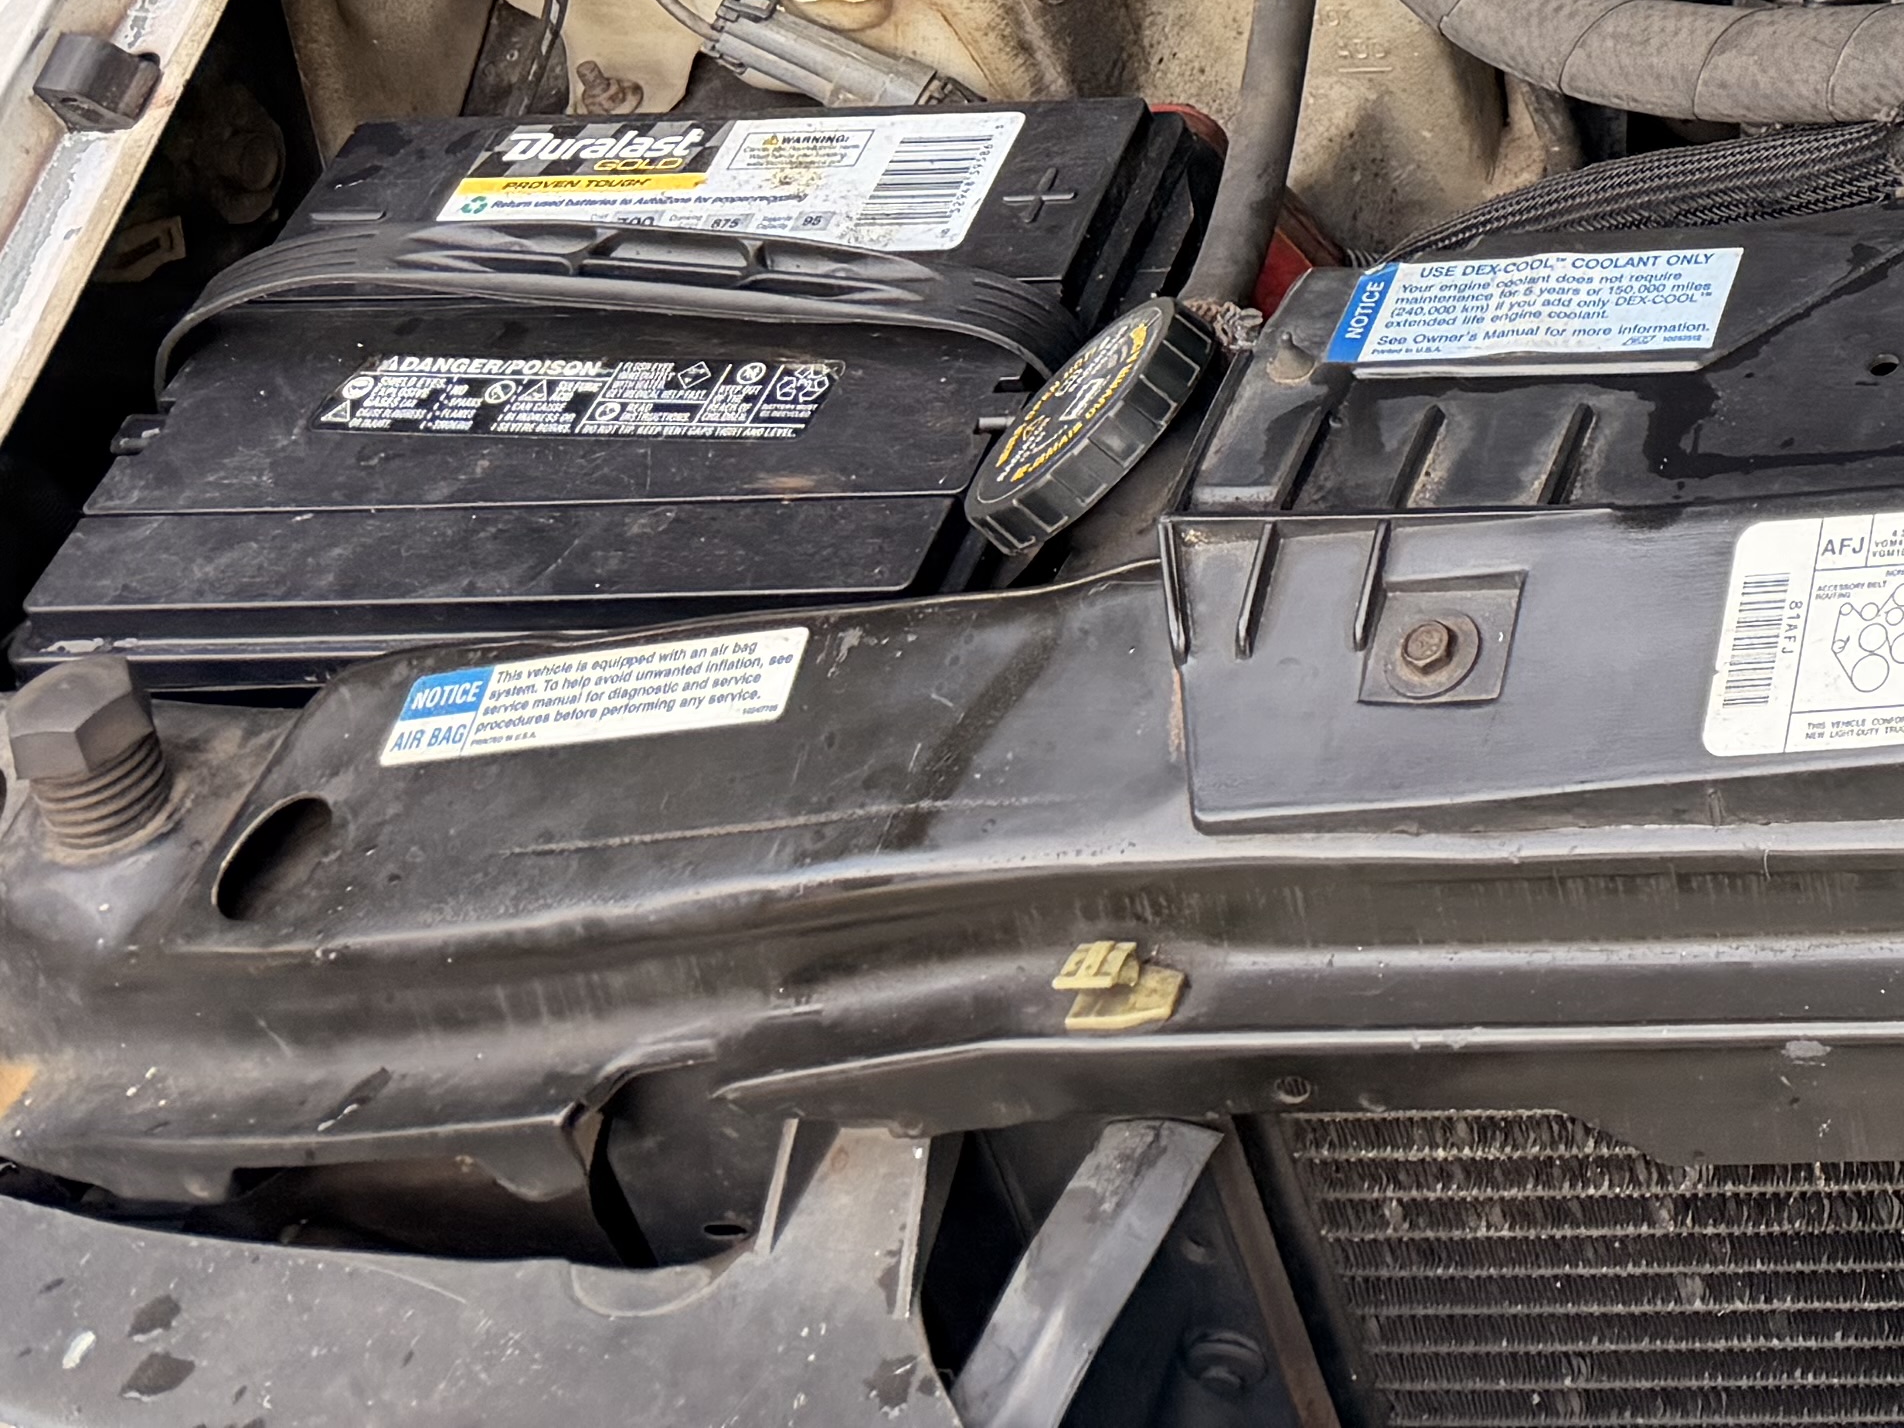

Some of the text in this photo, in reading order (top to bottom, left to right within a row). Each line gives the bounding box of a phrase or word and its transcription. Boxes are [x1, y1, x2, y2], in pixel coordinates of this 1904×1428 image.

[502, 128, 704, 162] Duralast
[593, 158, 683, 171] GOLD
[502, 178, 651, 190] PROVEN TOUGH
[492, 200, 531, 208] Return
[534, 199, 563, 208] used
[566, 198, 616, 206] batteries
[803, 215, 821, 226] 95
[1420, 265, 1455, 278] USE
[1572, 255, 1663, 270] COOLANT
[1667, 252, 1714, 267] ONLY
[1395, 291, 1493, 305] maintenance
[1498, 288, 1521, 300] for
[1535, 286, 1581, 298] years
[1586, 286, 1601, 295] or
[1670, 281, 1712, 292] miles
[1402, 270, 1681, 294] Your engine coolant does not require
[1345, 281, 1384, 339] NOTICE
[1460, 302, 1489, 315] km)
[1495, 300, 1505, 311] if
[1507, 298, 1537, 312] you
[1541, 296, 1571, 308] add
[1576, 294, 1610, 309] only
[1384, 307, 1609, 329] extended life engine coolant.
[1376, 321, 1710, 347] See Owner's Manual for more information.
[400, 357, 601, 376] DANGER/POISON
[1821, 538, 1863, 556] AFJ
[1817, 583, 1865, 592] ACCESSORY
[1781, 601, 1803, 654] 81AFJ
[496, 640, 757, 684] This vehicle is equipped with an air bag
[488, 653, 793, 702] system. To help avoid unwanted inflation, see
[410, 682, 483, 710] NOTICE
[483, 671, 762, 716] service manual for diagnostic and service
[475, 689, 761, 735] procedures before performing any service.
[390, 724, 468, 754] AIR BAG
